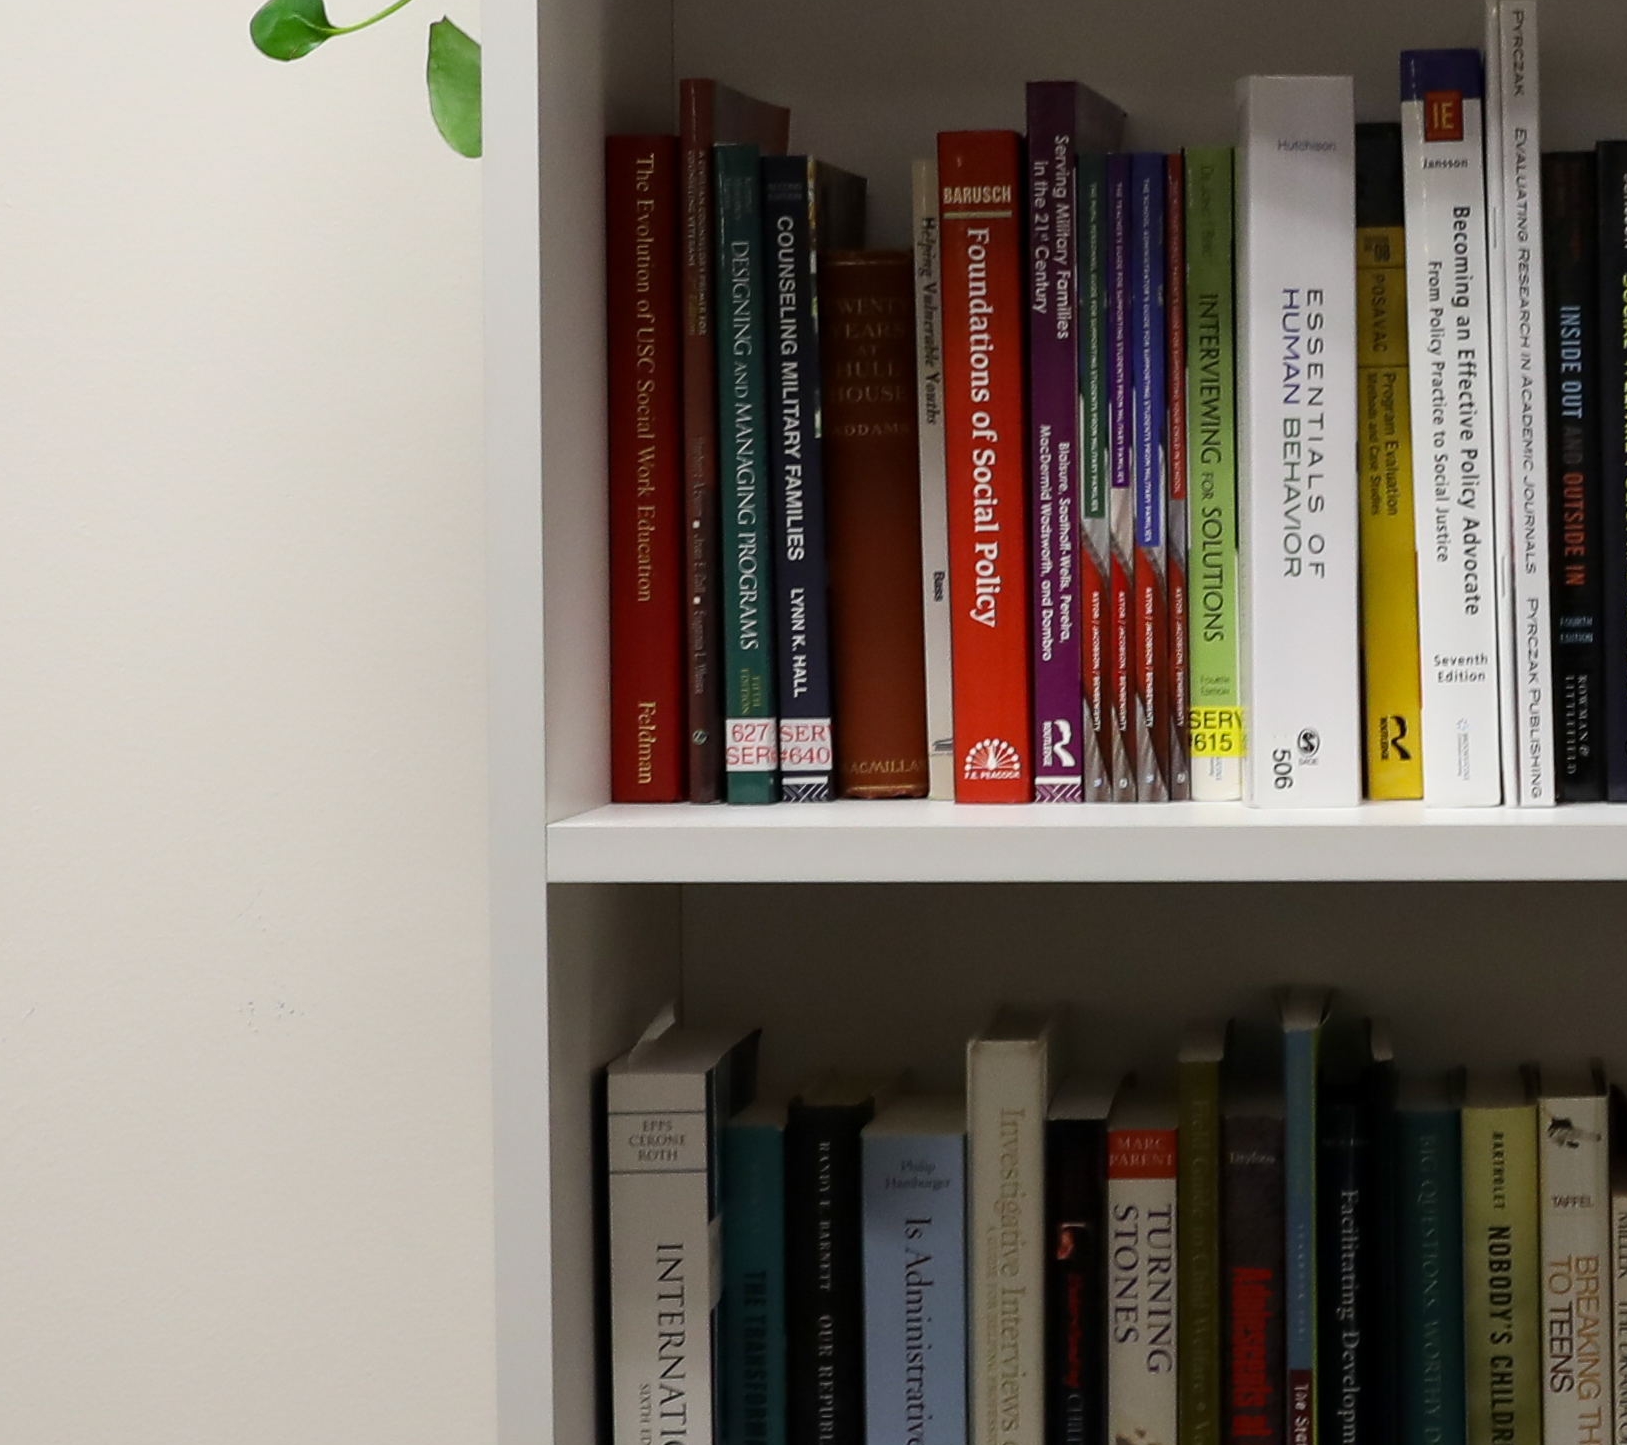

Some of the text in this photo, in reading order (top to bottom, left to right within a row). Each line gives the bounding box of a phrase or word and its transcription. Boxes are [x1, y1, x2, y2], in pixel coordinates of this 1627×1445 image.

[943, 186, 1011, 204] BARUSCH
[1422, 159, 1468, 168] Jansson
[777, 215, 798, 354] COUNSELING
[1051, 135, 1072, 339] Serving Military Families
[1372, 273, 1387, 352] POSAVAC
[783, 361, 801, 458] MILITARY
[968, 227, 1003, 628] Foundations of Social Policy
[1283, 289, 1301, 577] HUMAN BEHAVIOR
[1307, 290, 1324, 579] ESSENTIALS OF
[1427, 261, 1450, 563] From Policy Practice to Social Justice
[1453, 206, 1481, 615] Becoming an Effective Policy Advocate
[785, 465, 804, 560] FAMILIES
[934, 571, 946, 601] Bass
[790, 588, 808, 697] LYNN K. HALL
[1434, 654, 1488, 665] Seventh
[637, 701, 657, 784] Feldman
[732, 724, 766, 742] 627
[1273, 749, 1292, 789] 506
[642, 1121, 673, 1131] EPPS
[1492, 1132, 1505, 1209] BARTHOLET
[905, 1218, 932, 1239] Is
[1113, 1205, 1138, 1344] STONES
[1336, 1189, 1360, 1320] Facilitating
[1147, 1204, 1172, 1373] TURNING
[1575, 1257, 1601, 1399] BREAKING
[1294, 1384, 1309, 1410] The
